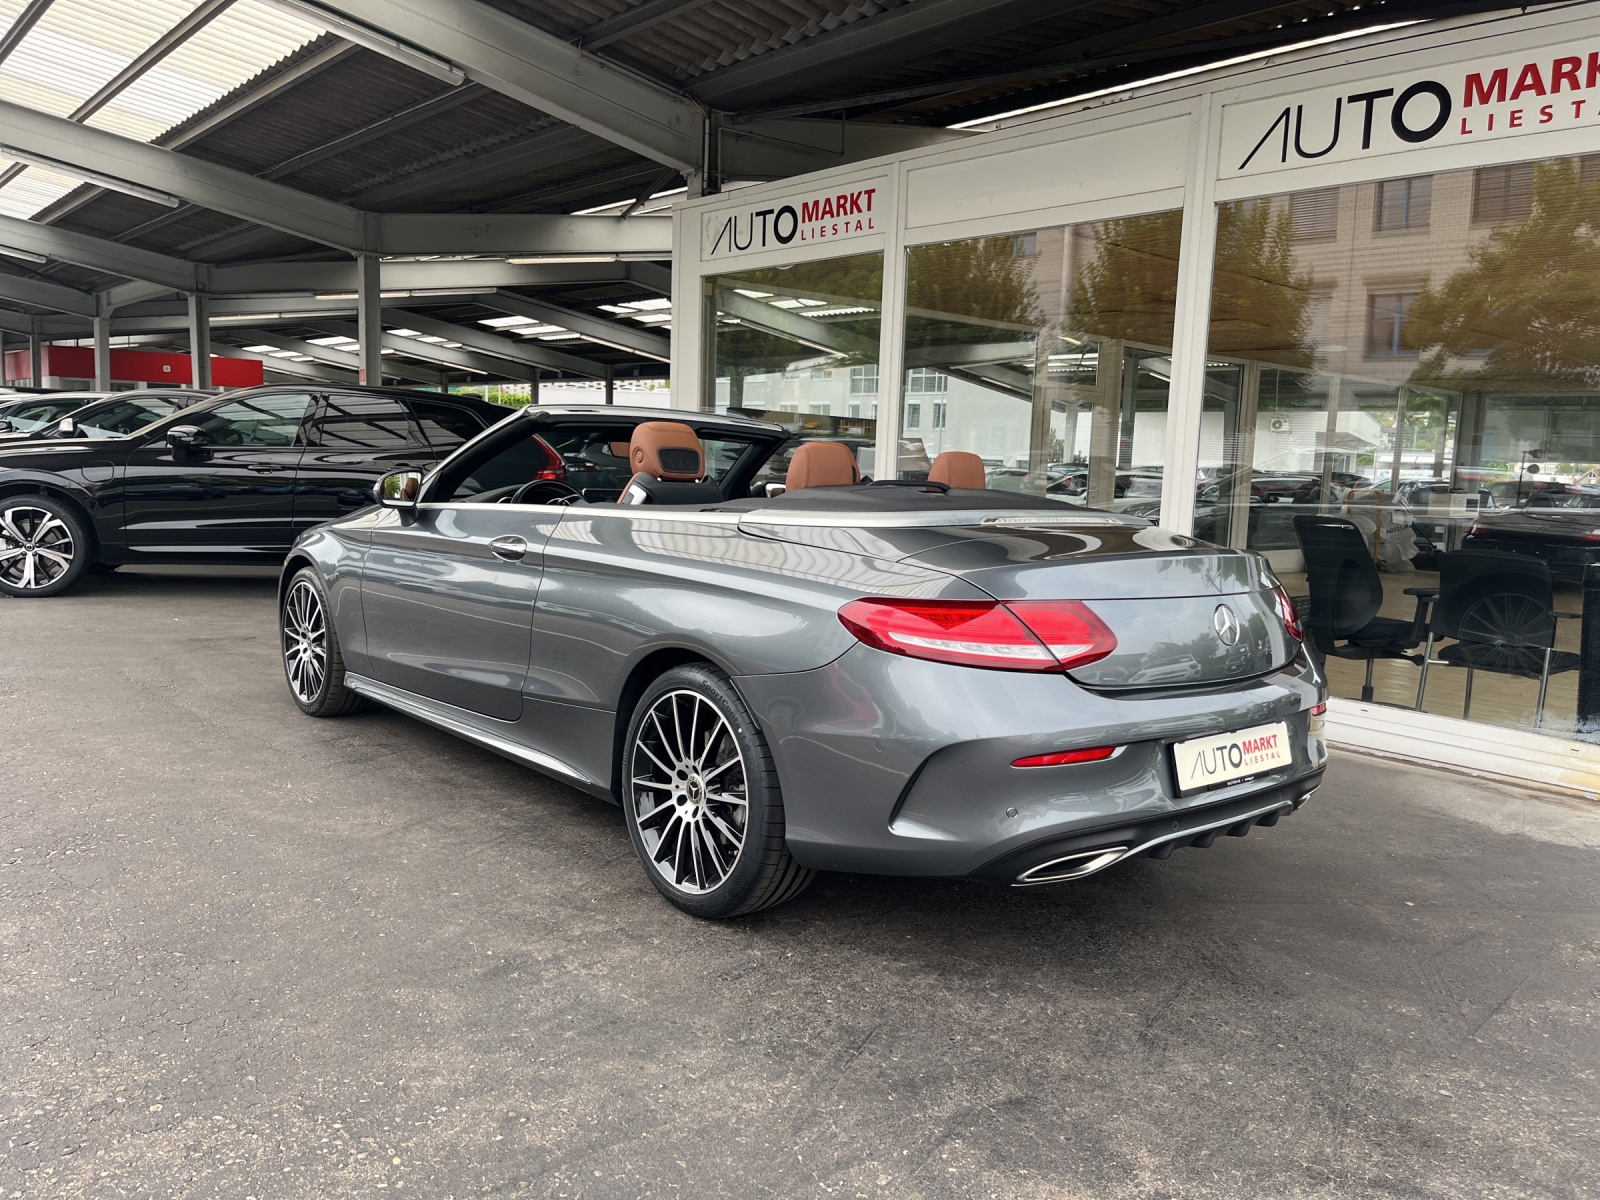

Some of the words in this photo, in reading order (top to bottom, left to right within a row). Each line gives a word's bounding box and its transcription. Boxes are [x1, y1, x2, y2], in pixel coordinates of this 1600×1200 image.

[1238, 80, 1451, 170] AUTO
[1460, 100, 1600, 135] LIEST
[711, 205, 798, 255] AUTO
[801, 188, 876, 223] MARKT
[801, 217, 874, 240] LIESTAL
[1191, 743, 1242, 779] AUTO
[1242, 734, 1277, 755] MARKT
[1244, 753, 1280, 766] LIESTAL
